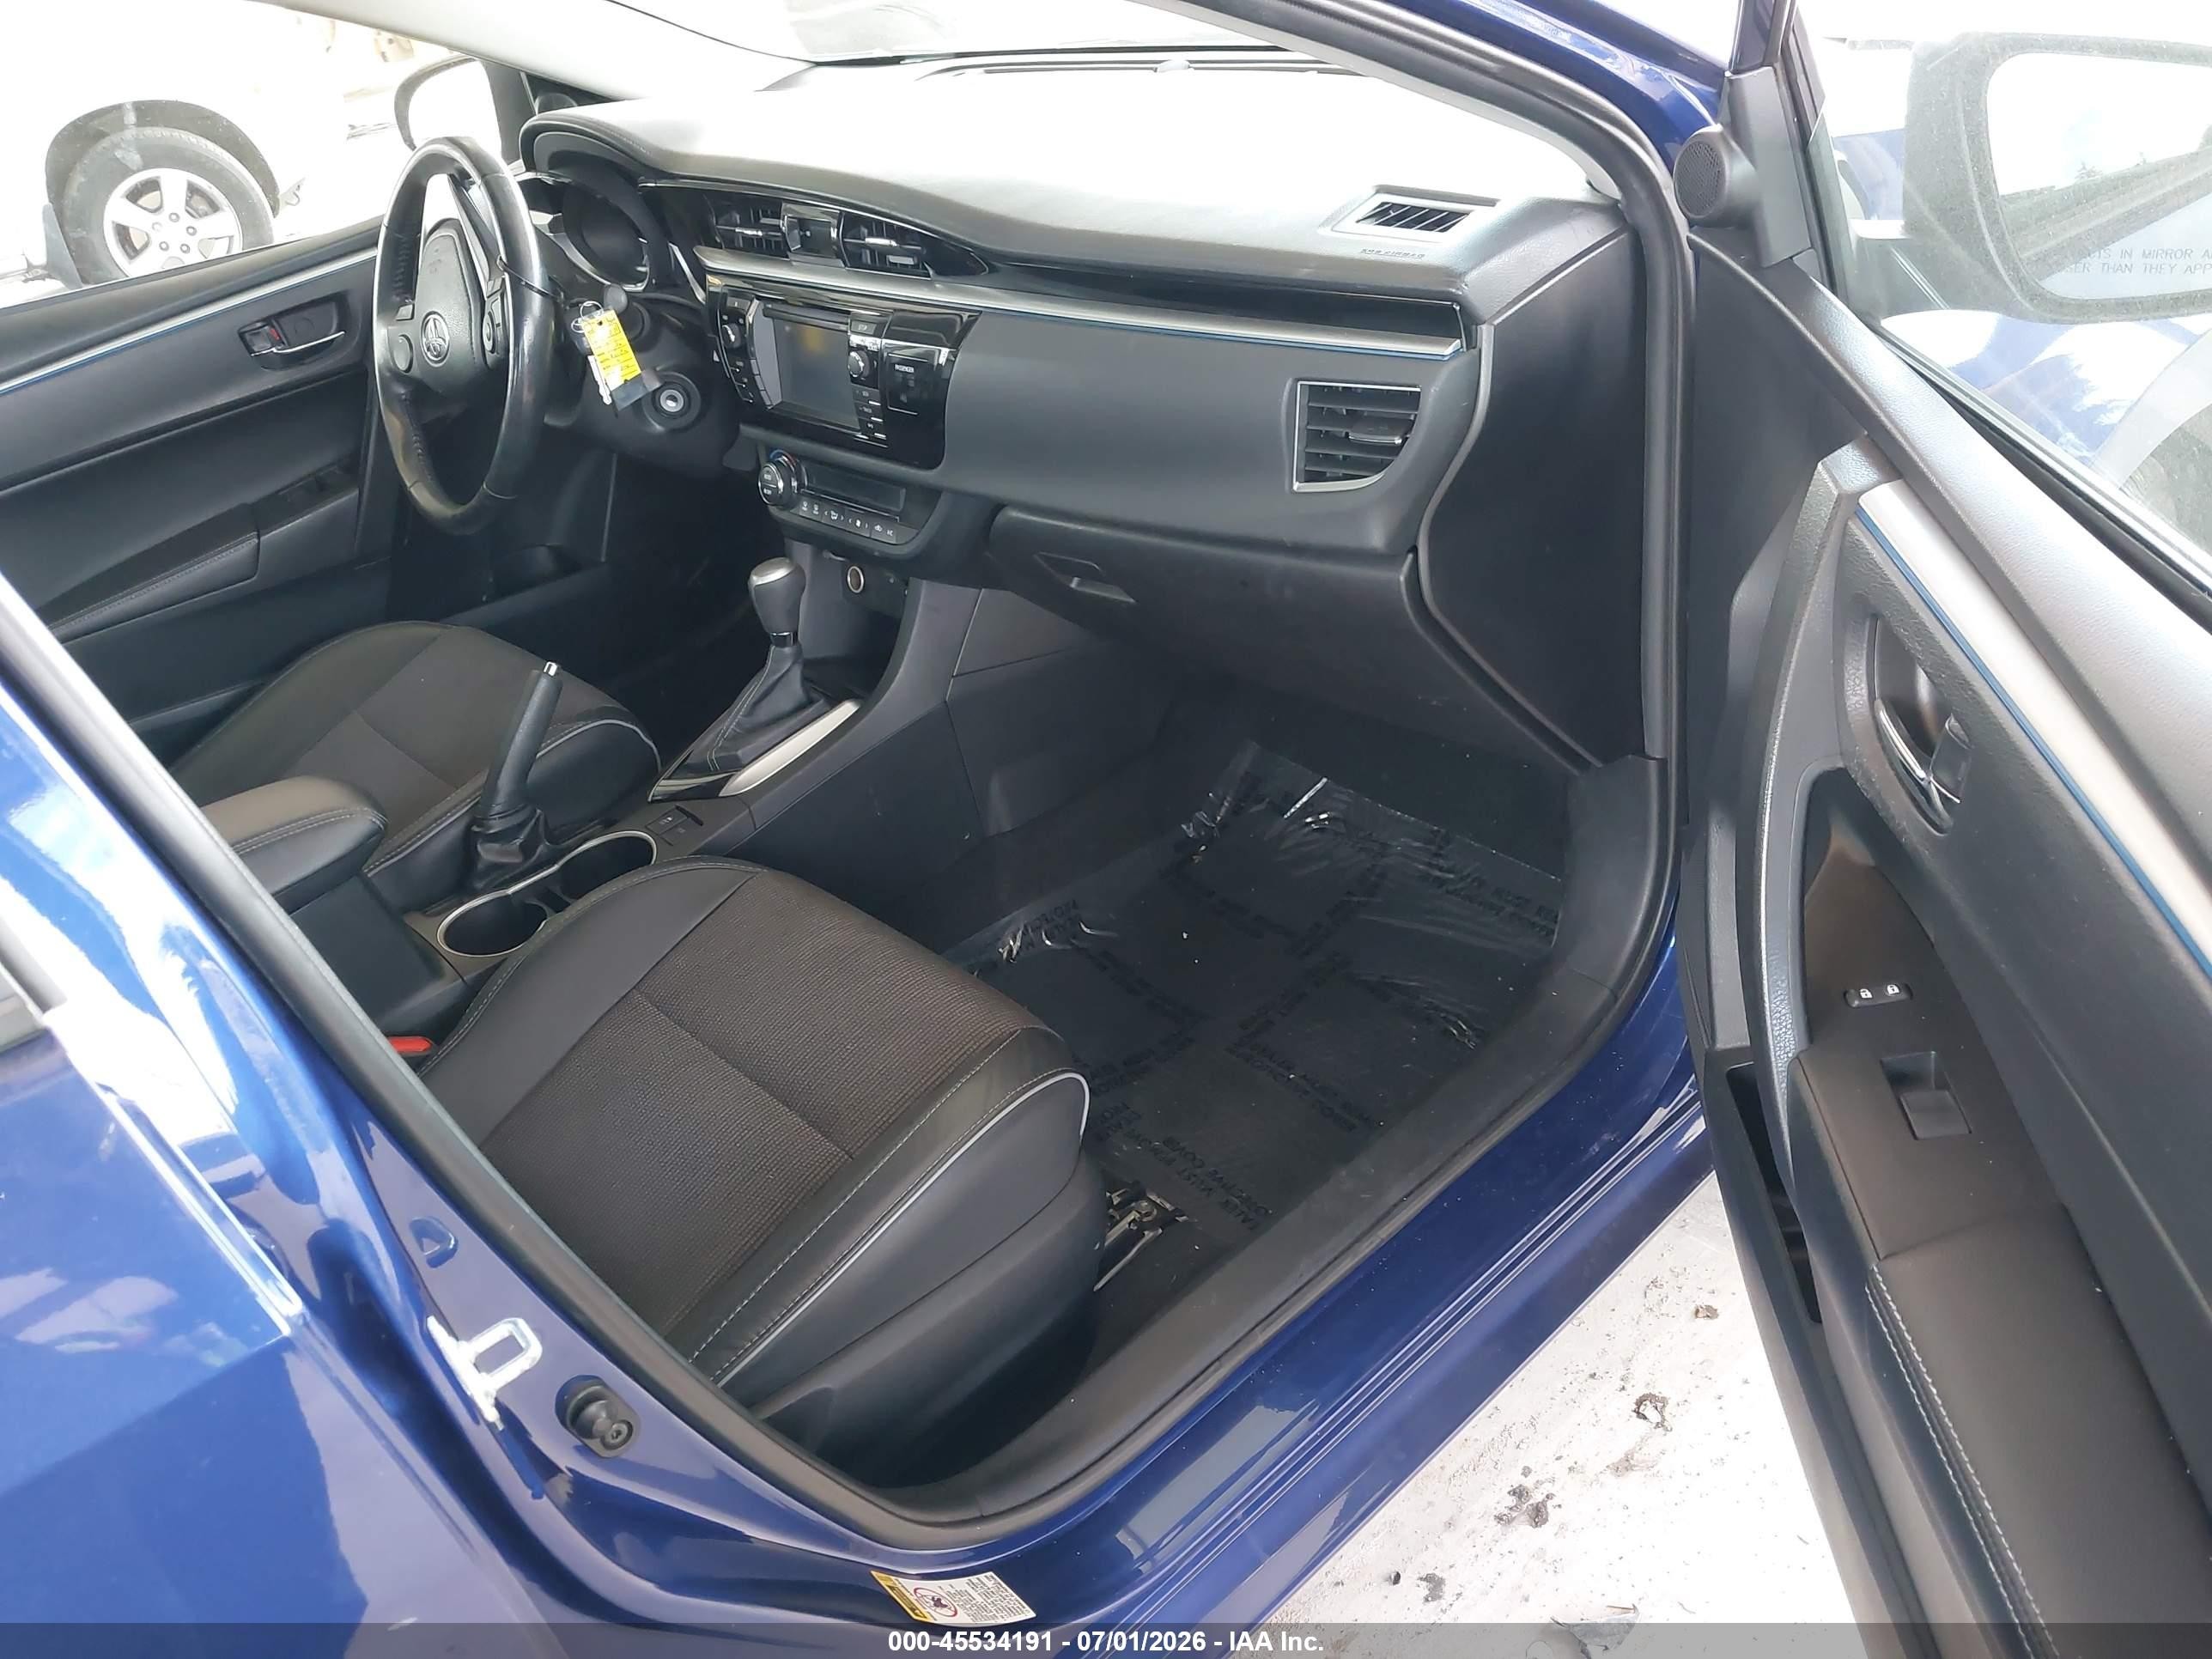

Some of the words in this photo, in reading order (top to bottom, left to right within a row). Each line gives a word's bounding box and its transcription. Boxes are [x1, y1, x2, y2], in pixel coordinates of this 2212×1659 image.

[2120, 247, 2133, 259] IN
[2141, 247, 2193, 259] MIRROR
[2101, 262, 2133, 274] THAN
[2142, 262, 2178, 274] THEY
